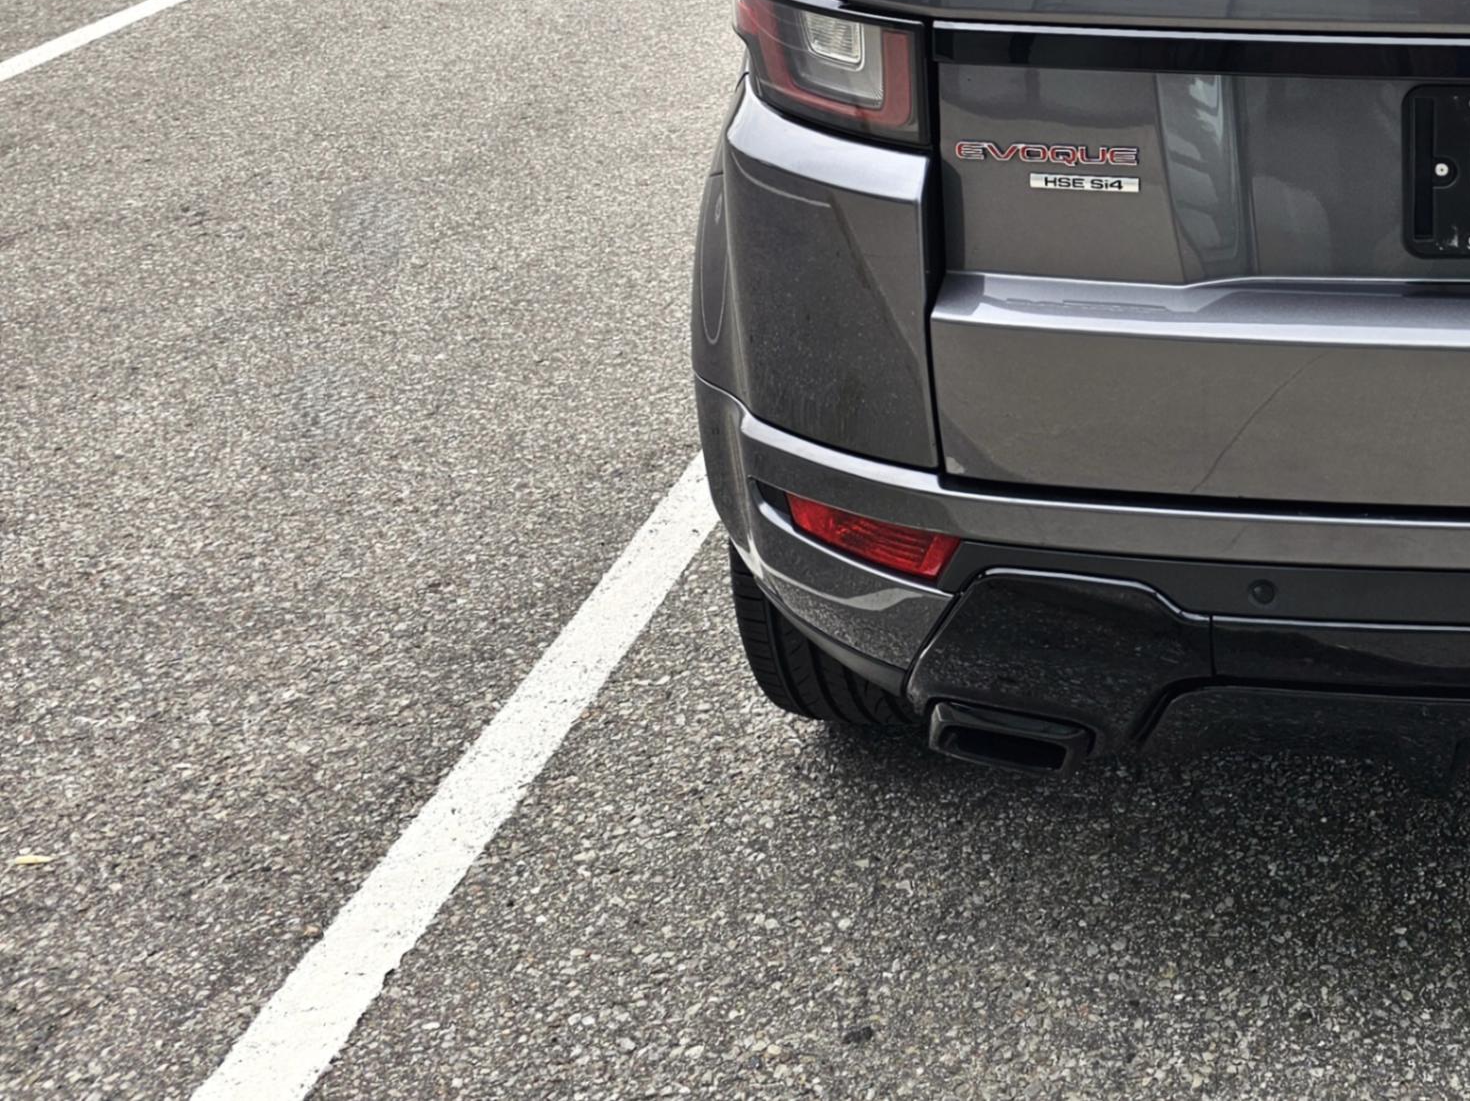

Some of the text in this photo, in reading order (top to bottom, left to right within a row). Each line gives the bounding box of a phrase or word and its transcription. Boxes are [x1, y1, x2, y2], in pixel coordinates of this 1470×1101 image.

[955, 141, 1139, 167] EVOQUE
[1044, 176, 1124, 190] HSE Si4
